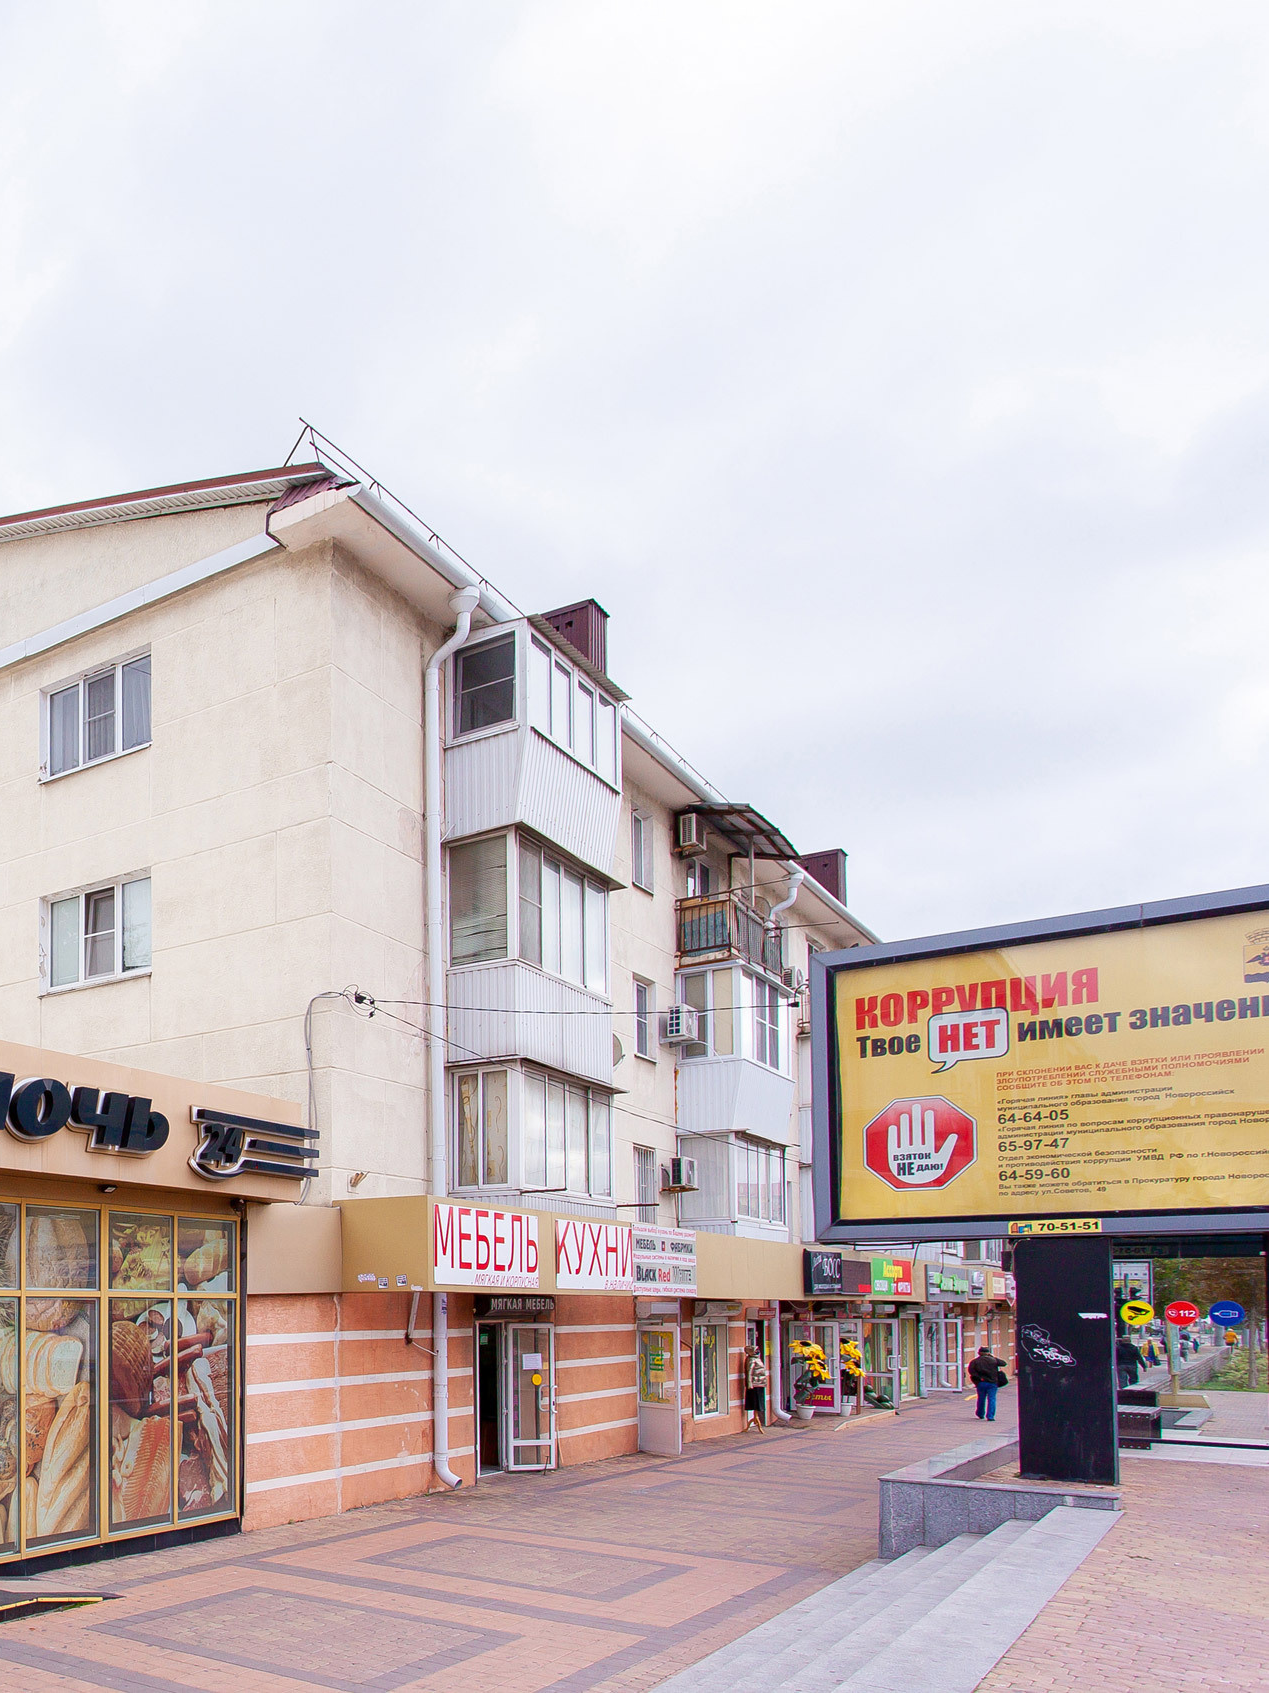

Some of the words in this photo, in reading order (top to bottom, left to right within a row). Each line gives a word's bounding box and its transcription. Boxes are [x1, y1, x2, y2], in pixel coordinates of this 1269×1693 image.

[856, 967, 1098, 1030] КОРРУПЦИЯ
[856, 1034, 921, 1058] Твое
[938, 1019, 1001, 1054] НЕТ
[1018, 1012, 1121, 1042] имеет
[1017, 1066, 1072, 1076] СКЛОНЕНИИ
[1103, 1060, 1128, 1069] ДАЧЕ
[1131, 1057, 1168, 1066] ВЗЯТКИ
[1194, 1048, 1265, 1060] ПРОЯВЛЕНИИ
[1089, 1064, 1158, 1076] СЛУЖЕБНЫМИ
[1161, 1057, 1250, 1070] ПОЛНОМОЧИЯМИ
[996, 1082, 1048, 1091] СООБЩИТЕ
[1065, 1078, 1091, 1086] ЭТОМ
[1111, 1071, 1175, 1082] ТЕЛЕФОНАМ:
[1101, 1086, 1173, 1097] администрации
[997, 1102, 1068, 1113] муниципального
[1071, 1097, 1128, 1107] образования
[1133, 1094, 1160, 1102] город
[1165, 1089, 1235, 1099] Новороссийск
[997, 1109, 1069, 1124] 64-64-05
[1080, 1119, 1124, 1128] вопросам
[1126, 1113, 1201, 1124] коррупционных
[998, 1130, 1064, 1140] администрации
[1066, 1125, 1141, 1136] муниципального
[1144, 1121, 1205, 1131] образования
[1208, 1119, 1237, 1127] город
[198, 1122, 246, 1166] 24
[998, 1137, 1069, 1152] 65-97-47
[893, 1152, 932, 1161] ВЗЯТОК
[1005, 1158, 1081, 1169] противодействия
[1083, 1156, 1132, 1165] коррупции
[1136, 1153, 1165, 1161] УМВД
[1026, 1151, 1092, 1161] экономической
[1094, 1148, 1158, 1157] безопасности
[896, 1162, 915, 1177] НЕ
[916, 1163, 943, 1172] ДАЮ!
[998, 1167, 1071, 1181] 64-59-60
[1072, 1179, 1122, 1187] обратиться
[1132, 1176, 1190, 1185] Прокуратуру
[1193, 1174, 1226, 1182] города
[1011, 1188, 1039, 1197] адресу
[1038, 1221, 1099, 1232] 70-51-51
[434, 1203, 538, 1273] МЕБЕЛЬ
[636, 1238, 656, 1250] МЕБЕЛЬ
[555, 1219, 633, 1277] КУХНИ
[474, 1273, 500, 1286] МЯГКАЯ
[505, 1276, 539, 1288] КОРПУСНАЯ
[658, 1268, 671, 1282] Red
[490, 1298, 522, 1311] МЯГКАЯ
[525, 1298, 555, 1310] МЕБЕЛЬ
